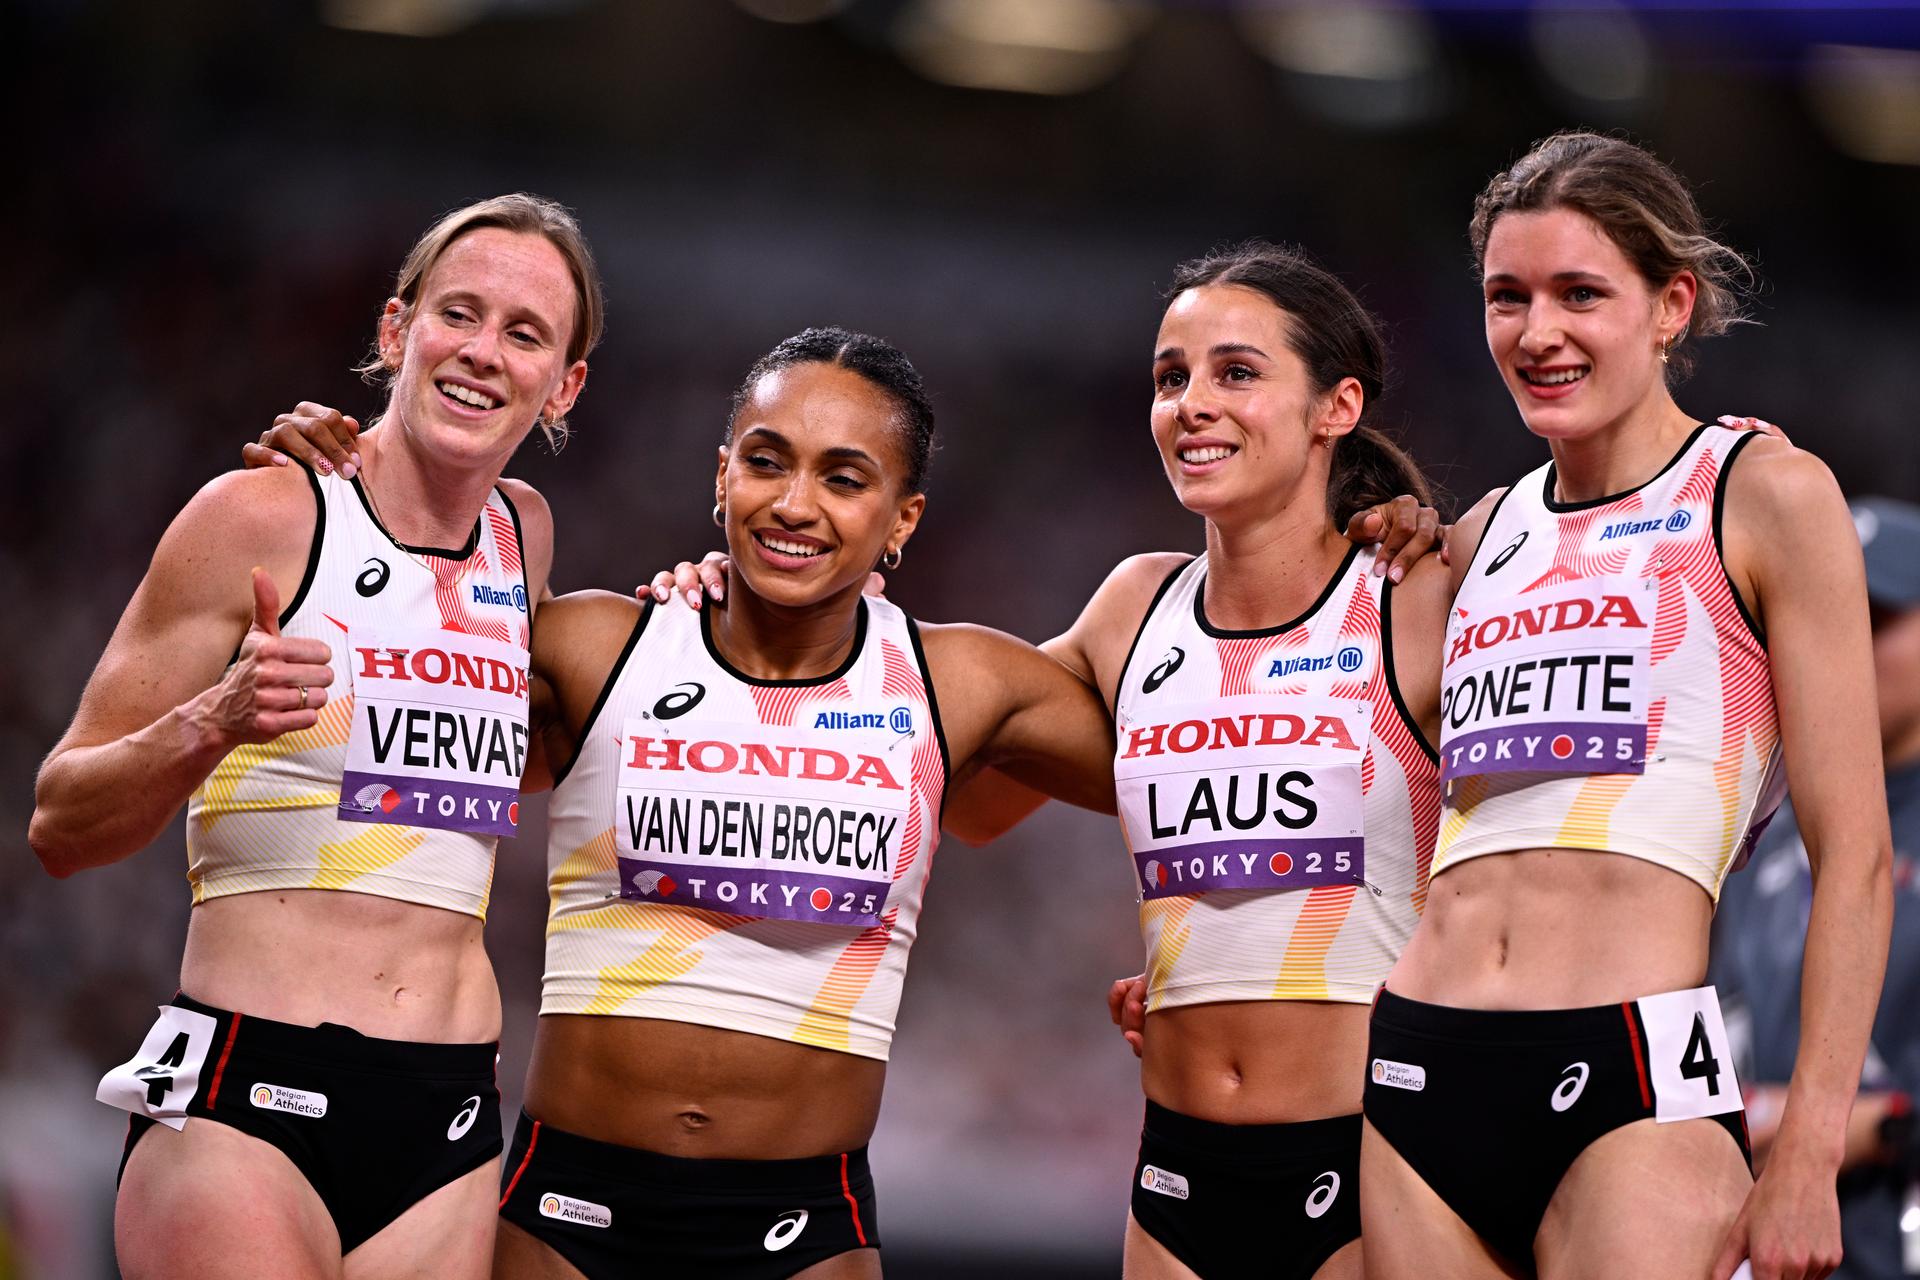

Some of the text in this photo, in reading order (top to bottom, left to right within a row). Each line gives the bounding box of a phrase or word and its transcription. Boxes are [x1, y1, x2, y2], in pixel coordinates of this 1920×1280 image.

[1600, 518, 1663, 541] Allianz
[472, 585, 513, 607] Allianz
[1446, 595, 1648, 669] HONDA
[355, 647, 529, 702] HONDA
[1267, 654, 1333, 678] Allianz
[1442, 655, 1634, 730] PONETTE
[813, 711, 885, 730] Allianz
[1120, 714, 1361, 760] HONDA
[367, 705, 528, 778] VERVAE
[626, 735, 905, 791] HONDA
[1147, 770, 1318, 840] LAUS
[626, 795, 898, 872] VAN DEN BROECK
[132, 1031, 190, 1108] 4
[1679, 1010, 1720, 1097] 4
[276, 1089, 306, 1101] Belgian
[1386, 1073, 1423, 1089] Athletics
[274, 1098, 323, 1116] Athletics
[563, 1200, 591, 1212] Belgian
[1155, 1180, 1187, 1198] Athletics
[562, 1208, 609, 1226] Athletics
